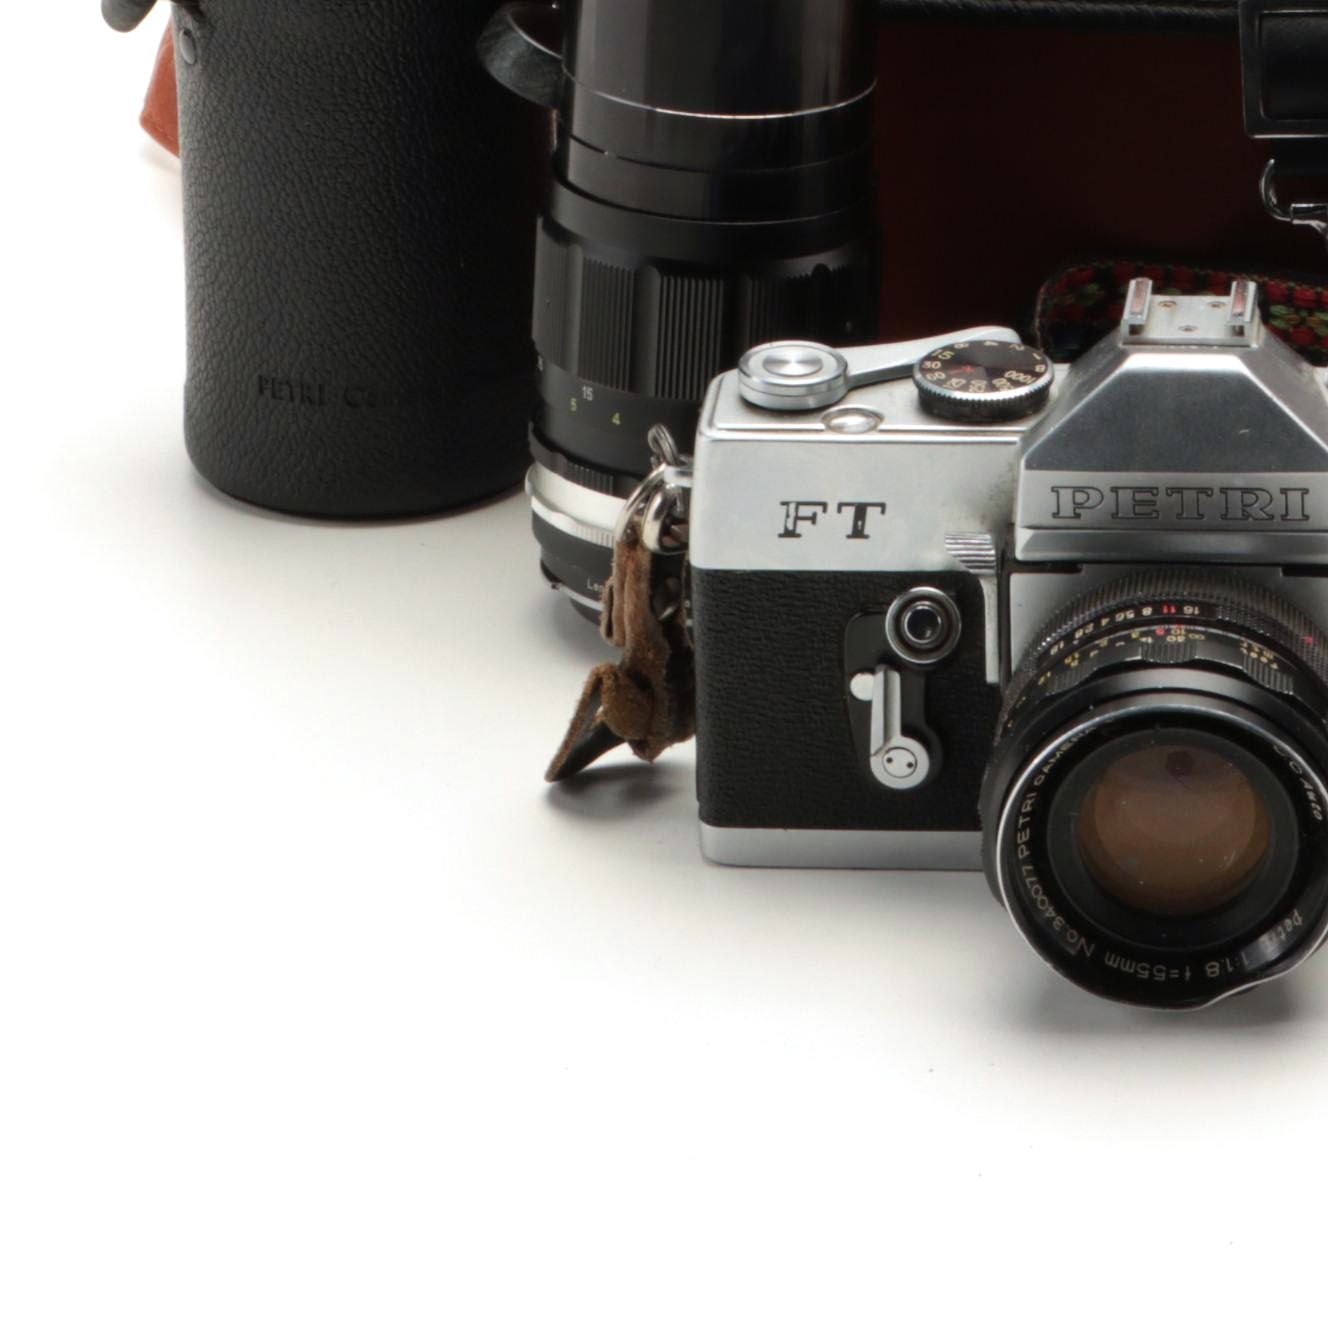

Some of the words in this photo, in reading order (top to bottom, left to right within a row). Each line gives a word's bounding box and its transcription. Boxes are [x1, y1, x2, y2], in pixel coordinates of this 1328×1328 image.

[582, 385, 594, 401] 15
[777, 501, 886, 539] FT
[1051, 486, 1310, 521] PETRI
[1162, 604, 1177, 615] 11
[1017, 791, 1037, 859] PETRI
